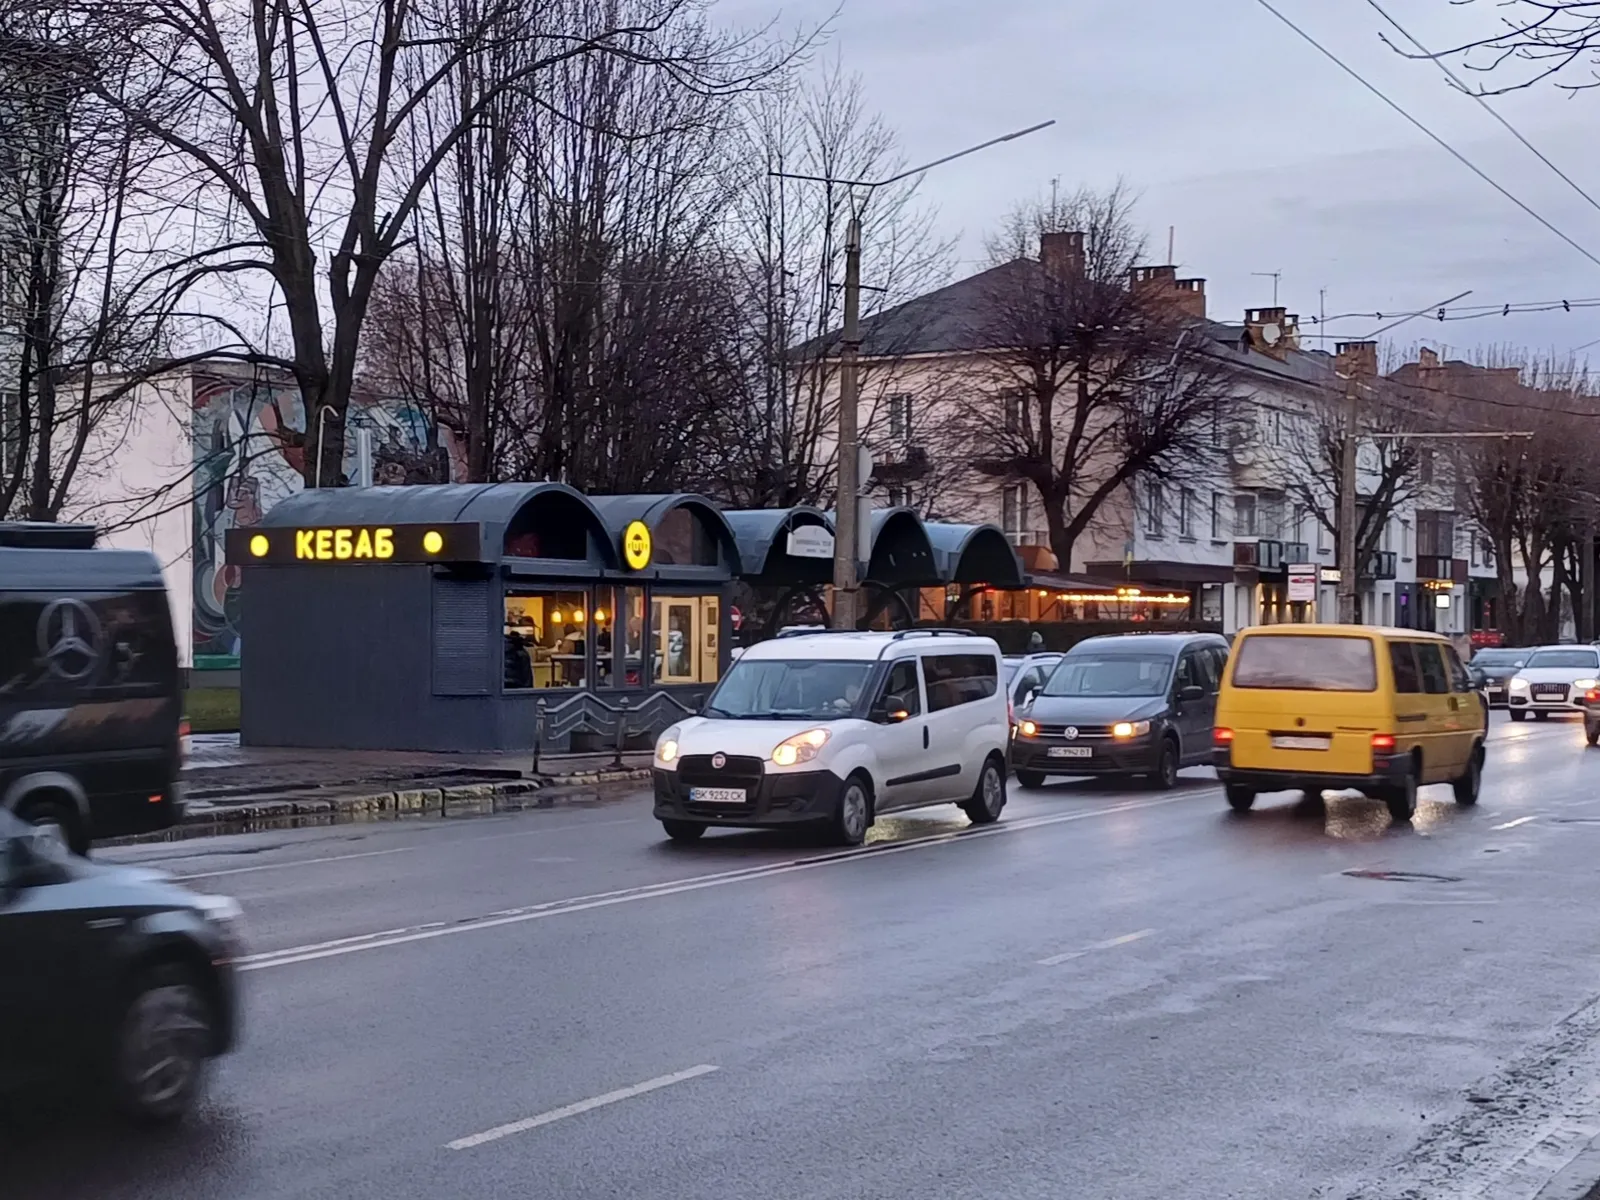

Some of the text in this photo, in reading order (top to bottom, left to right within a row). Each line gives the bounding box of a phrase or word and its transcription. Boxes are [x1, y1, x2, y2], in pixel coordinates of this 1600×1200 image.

[296, 528, 394, 559] КЕБАБ
[695, 790, 744, 801] BK 9252 CK
